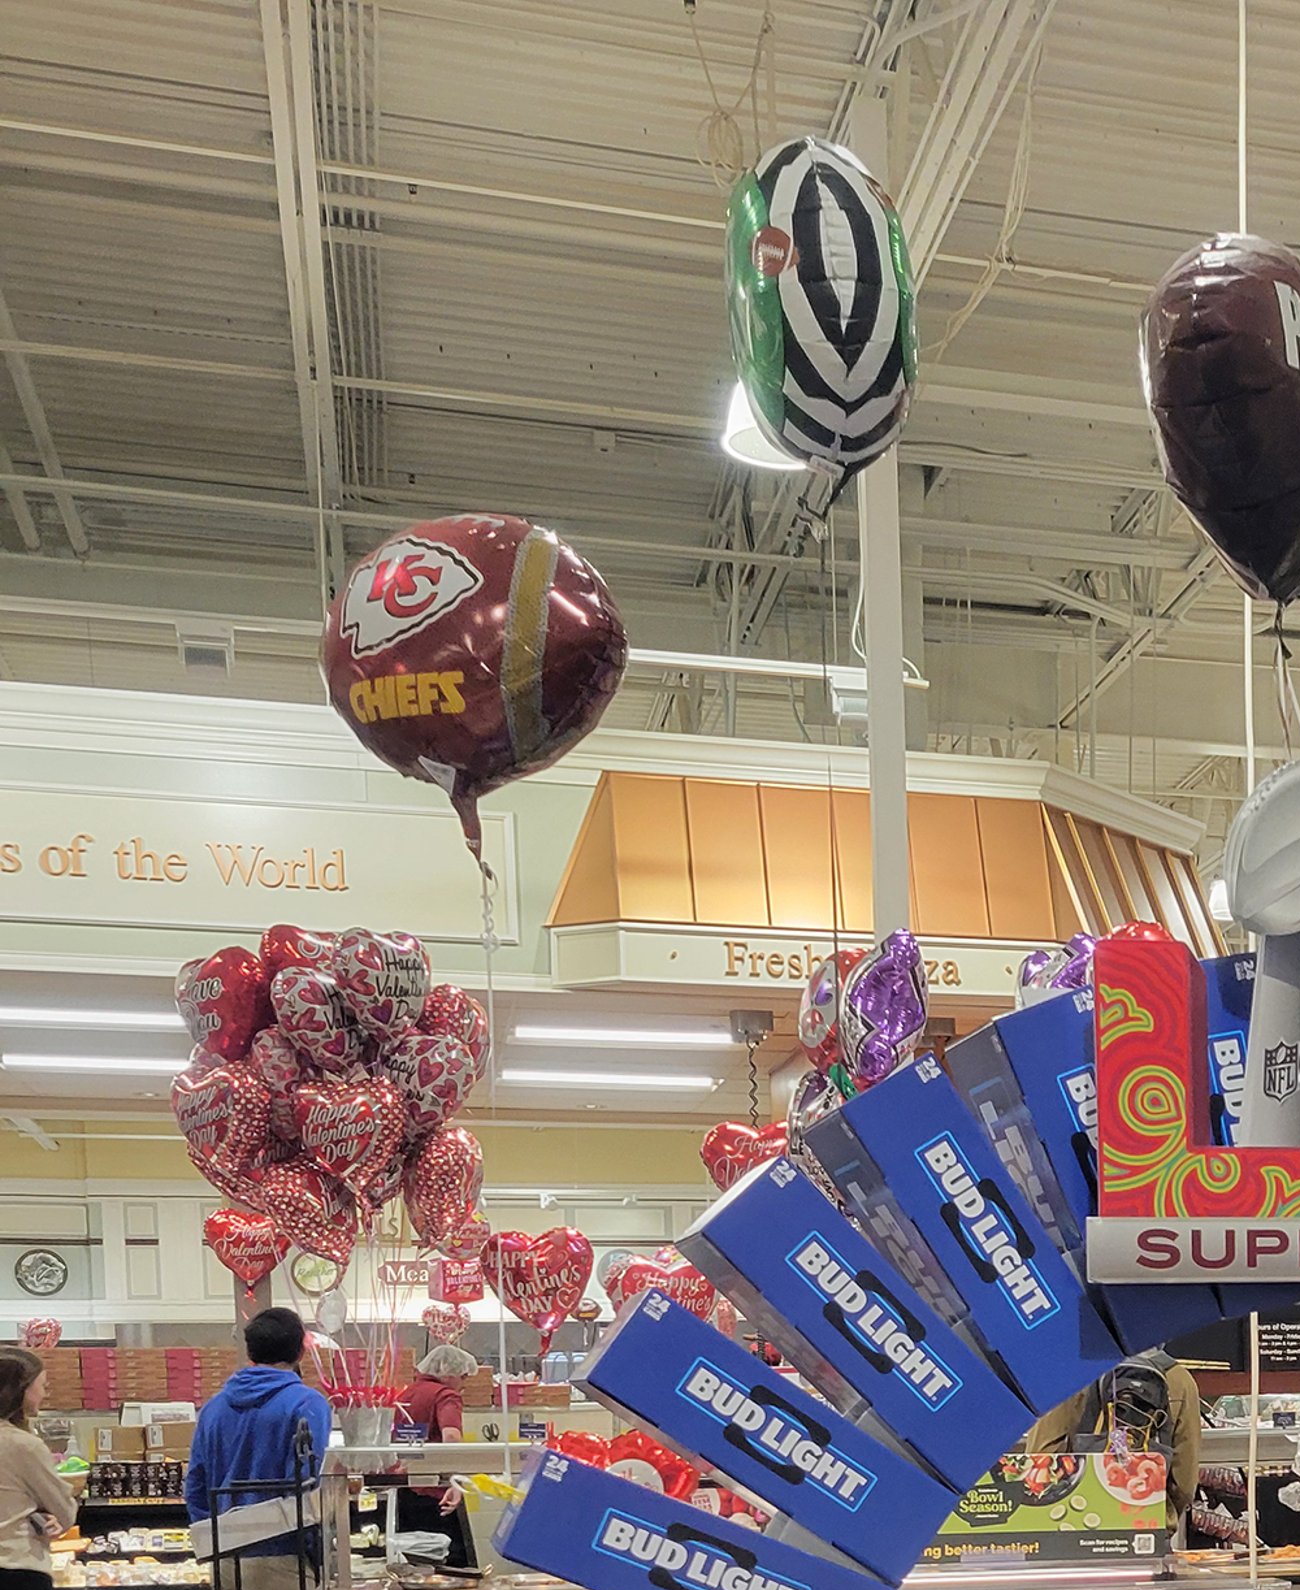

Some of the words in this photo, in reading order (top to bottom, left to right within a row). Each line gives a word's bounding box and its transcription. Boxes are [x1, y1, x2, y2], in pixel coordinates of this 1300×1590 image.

[367, 554, 443, 618] KC
[350, 671, 465, 724] CHIEFS
[38, 834, 92, 877] of
[114, 838, 189, 883] the
[208, 842, 349, 892] World
[724, 941, 824, 980] Fresh
[1266, 1064, 1296, 1094] NFL
[925, 1141, 985, 1218] BUD
[972, 1209, 1052, 1318] LIGHT
[386, 1265, 429, 1283] Mea
[489, 1251, 537, 1269] HAPPY
[521, 1298, 553, 1314] DAY
[796, 1240, 866, 1314] BUD
[858, 1303, 954, 1401] LIGHT
[685, 1367, 764, 1435] BUD
[756, 1405, 868, 1502] LIGHT
[959, 1501, 1013, 1513] Season!
[968, 1490, 1004, 1503] Bowl
[602, 1516, 684, 1571] BUD
[945, 1543, 993, 1556] better
[990, 1541, 1040, 1553] tastier!
